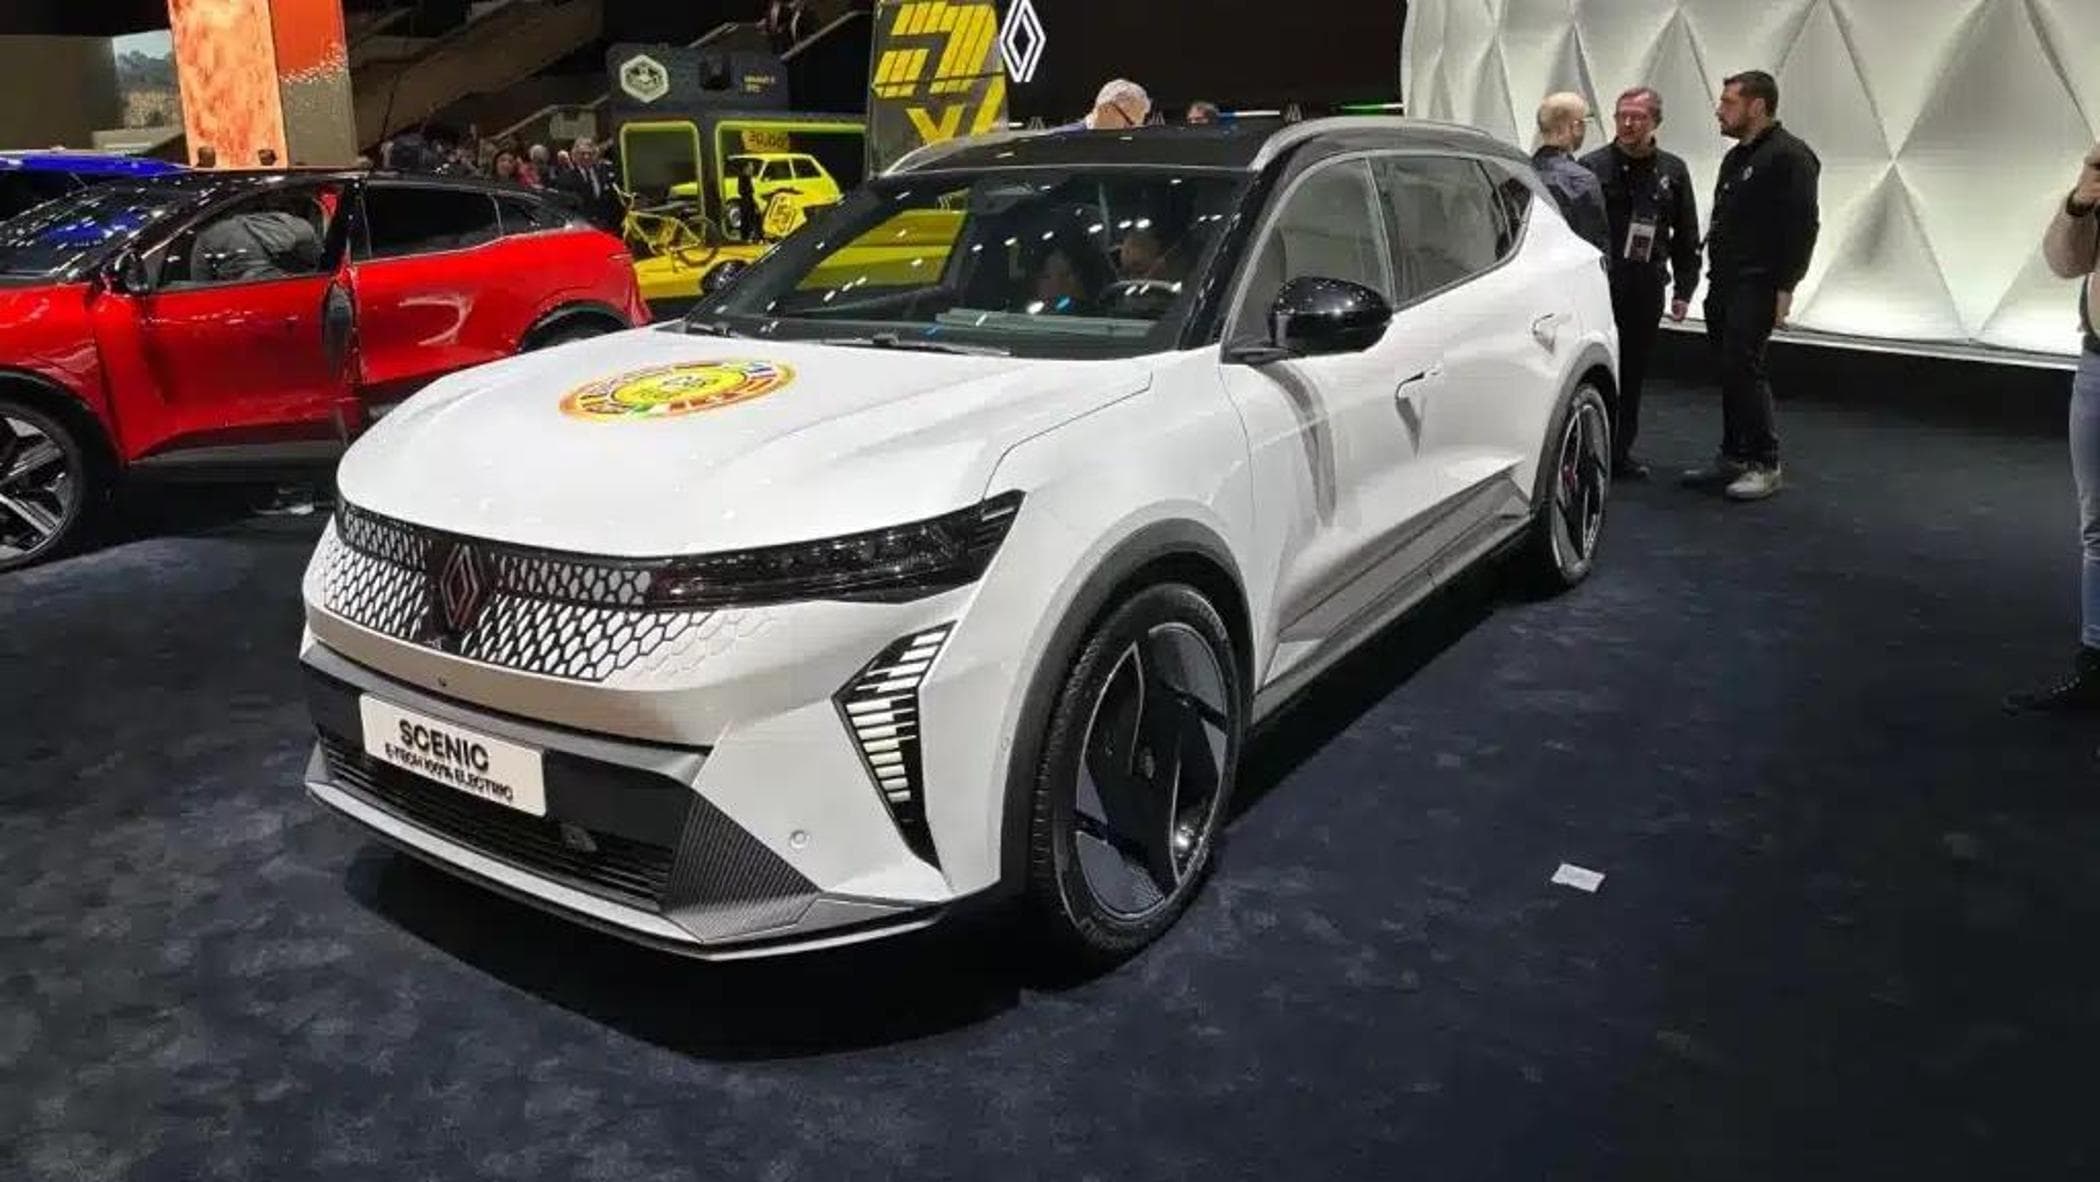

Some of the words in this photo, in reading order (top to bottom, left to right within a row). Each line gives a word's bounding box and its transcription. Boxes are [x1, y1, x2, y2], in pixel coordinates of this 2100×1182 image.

[385, 743, 423, 766] E-TECH
[455, 769, 513, 801] ELECTRIC
[399, 719, 489, 771] SCENIC
